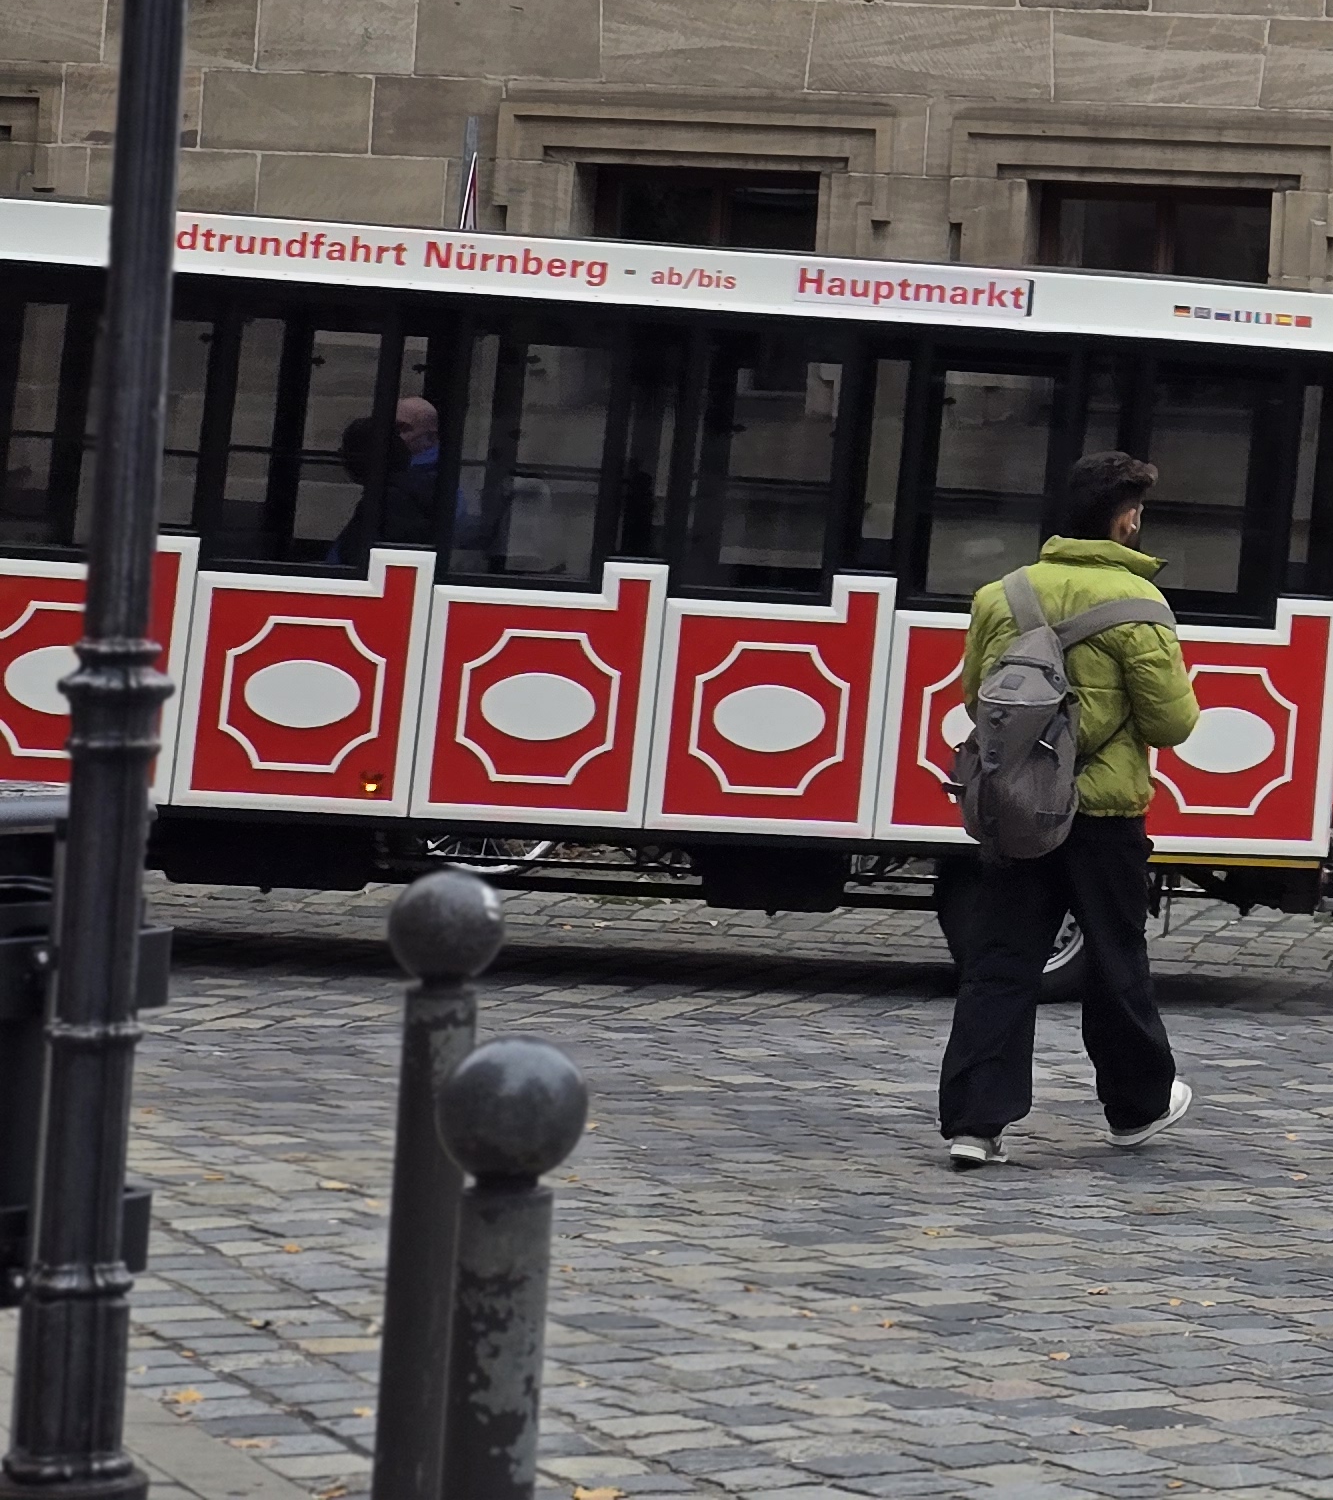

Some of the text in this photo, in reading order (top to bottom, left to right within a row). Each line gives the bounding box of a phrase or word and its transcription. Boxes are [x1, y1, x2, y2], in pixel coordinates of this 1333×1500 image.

[176, 223, 407, 266] dtrundfahrt
[425, 239, 608, 287] Nürnberg
[651, 266, 736, 289] ab/bis
[799, 267, 1024, 308] Hauptmarkt
